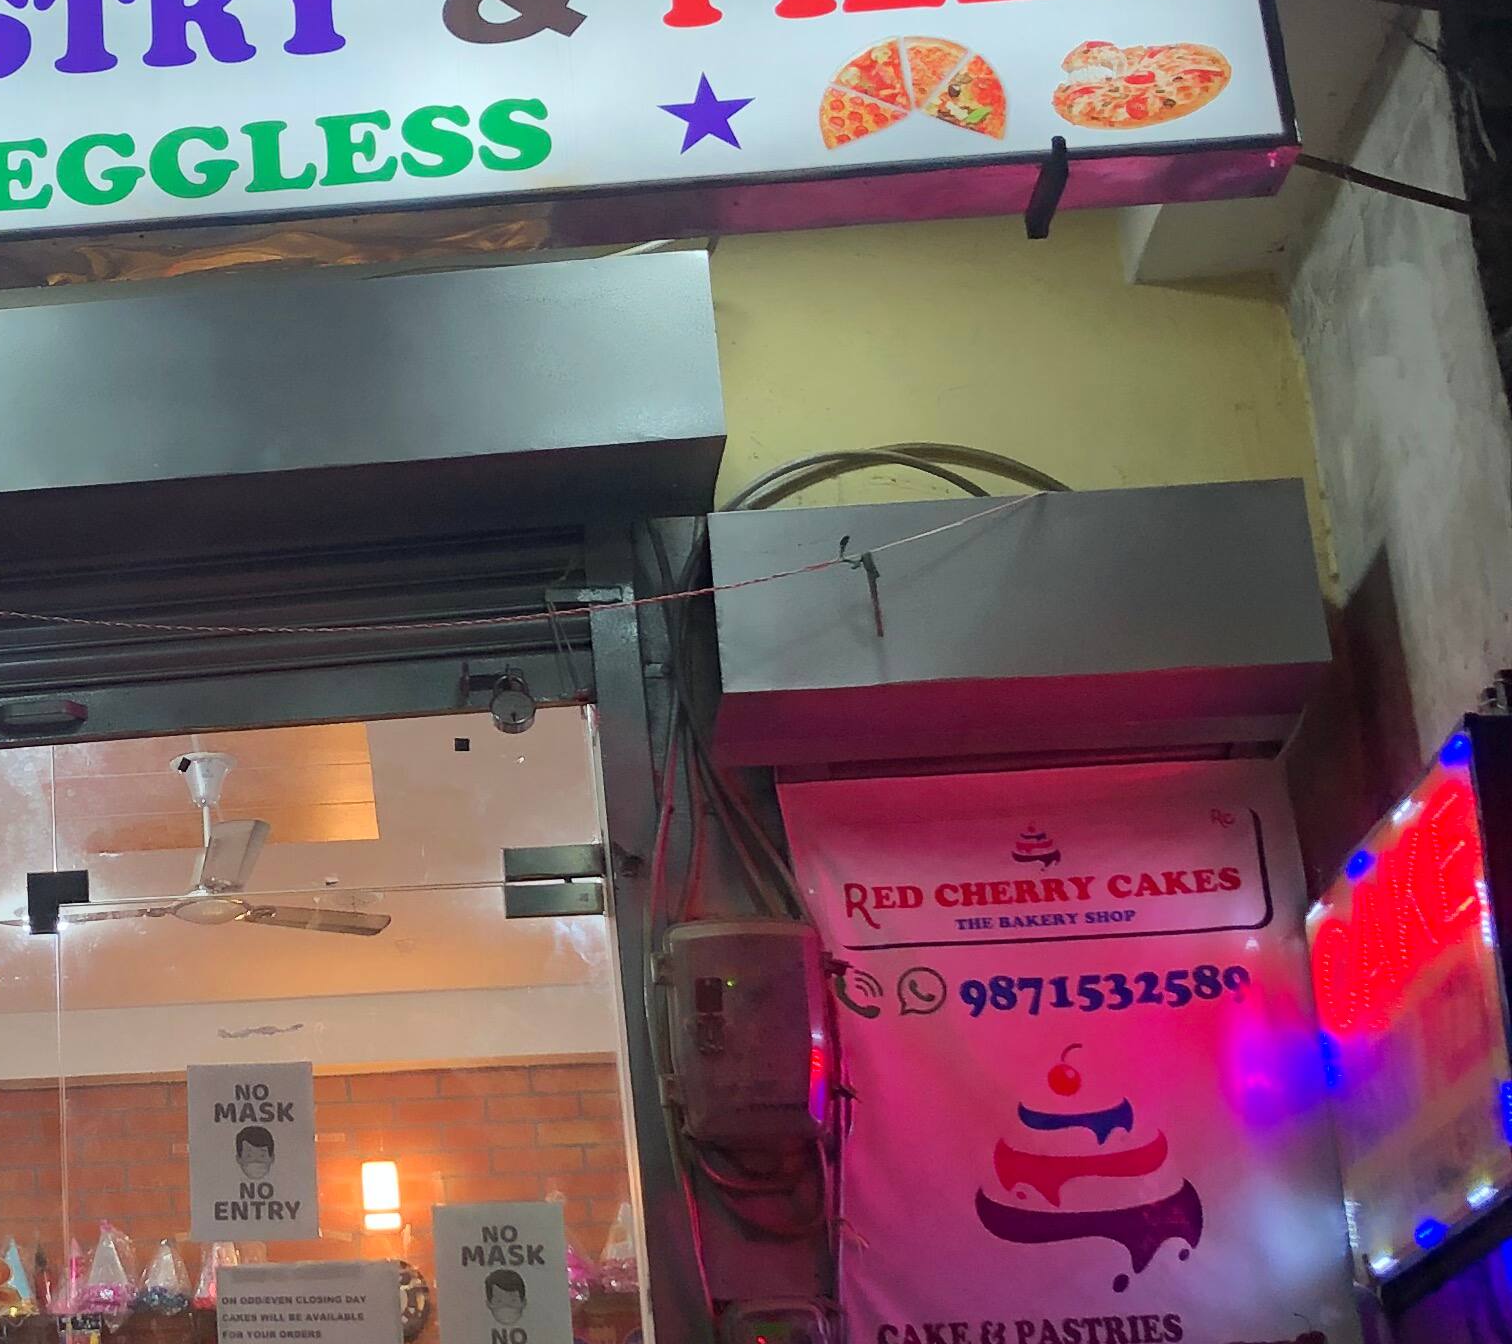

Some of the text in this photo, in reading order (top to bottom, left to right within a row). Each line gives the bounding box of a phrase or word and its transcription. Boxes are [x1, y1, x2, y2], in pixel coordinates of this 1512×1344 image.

[844, 866, 1243, 929] RED CHERRY CAKES
[955, 909, 1137, 931] THE BAKERY SHOP
[959, 963, 1251, 1018] 9871532589
[234, 1083, 270, 1102] NO
[213, 1102, 296, 1124] MASK
[239, 1181, 275, 1200] NO
[214, 1200, 302, 1222] ENTRY
[481, 1225, 519, 1243] NO
[461, 1244, 546, 1267] MASK
[296, 1295, 342, 1304] CLOSING
[345, 1295, 367, 1304] DAY
[222, 1312, 365, 1322] CAKES WILL BE AVAILABLE
[222, 1330, 321, 1339] FOR YOUR ORDERS
